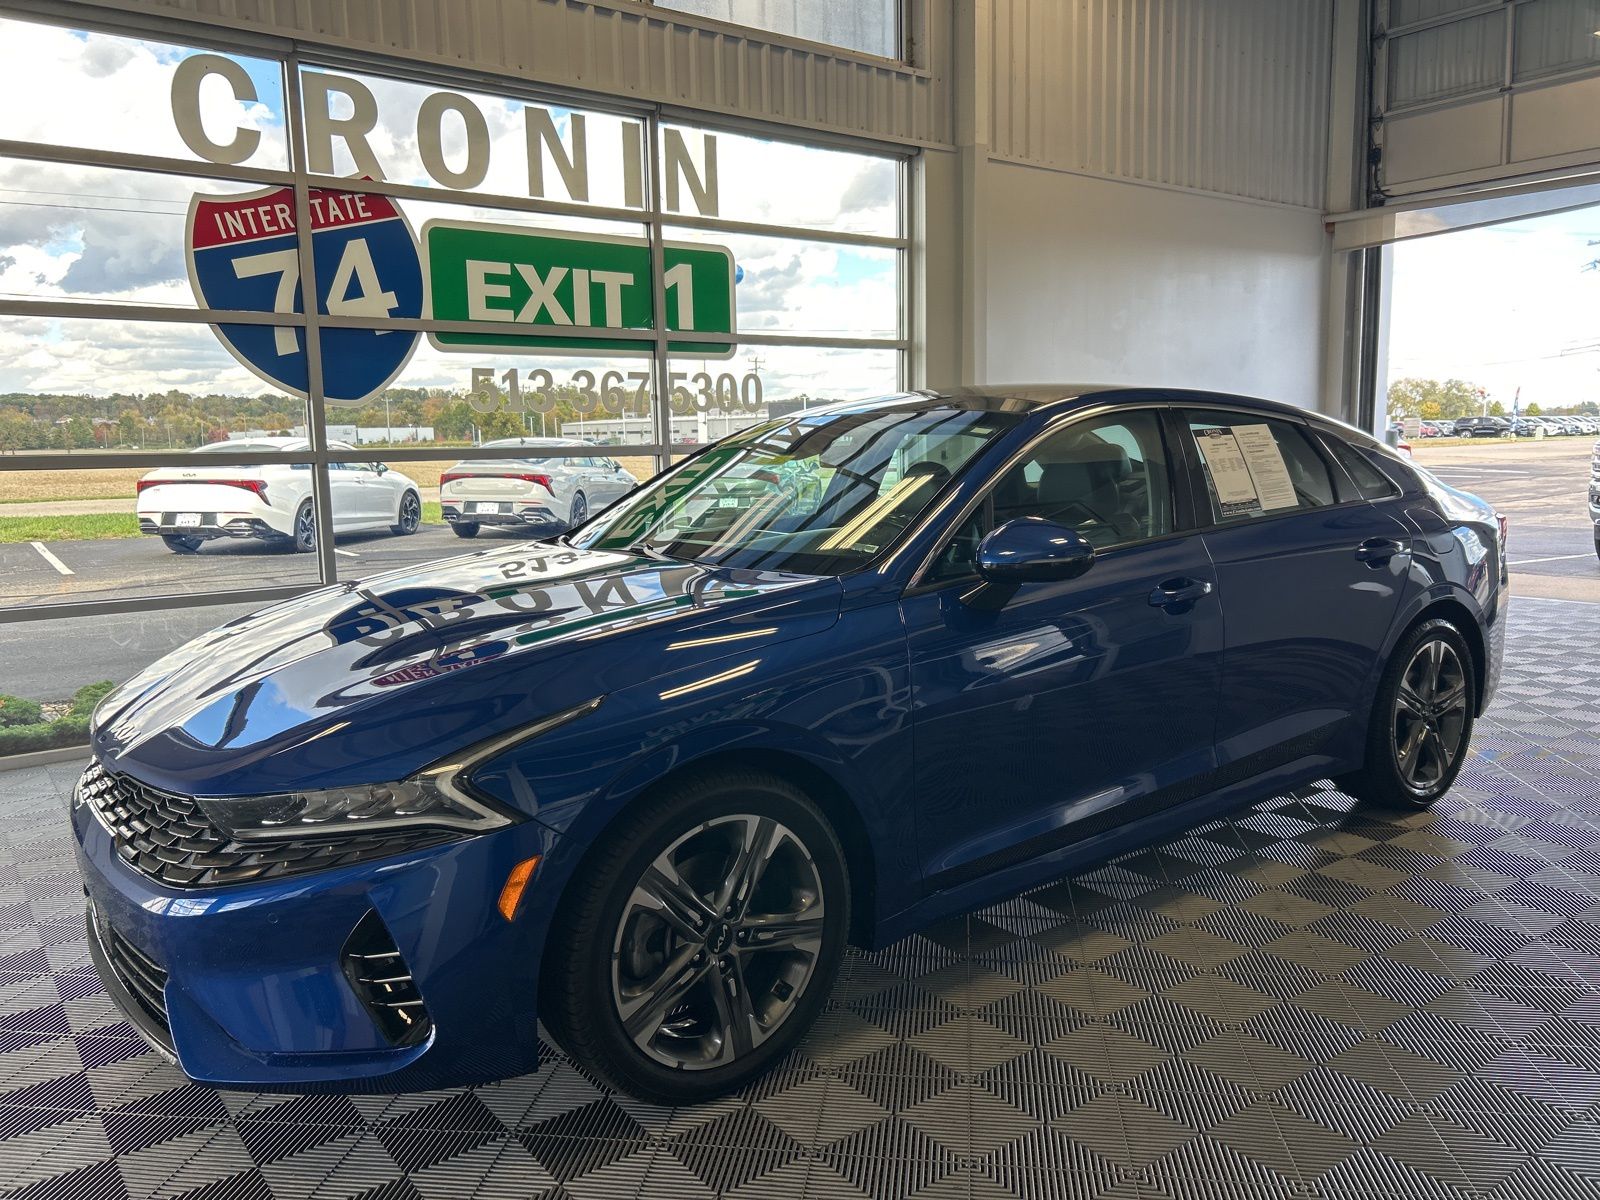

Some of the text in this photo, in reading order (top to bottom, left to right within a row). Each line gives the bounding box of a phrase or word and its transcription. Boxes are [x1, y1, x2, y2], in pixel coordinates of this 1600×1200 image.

[171, 54, 719, 217] CRONIN
[214, 193, 372, 239] INTERTATE
[231, 238, 399, 356] 74
[466, 260, 694, 330] EXIT 1
